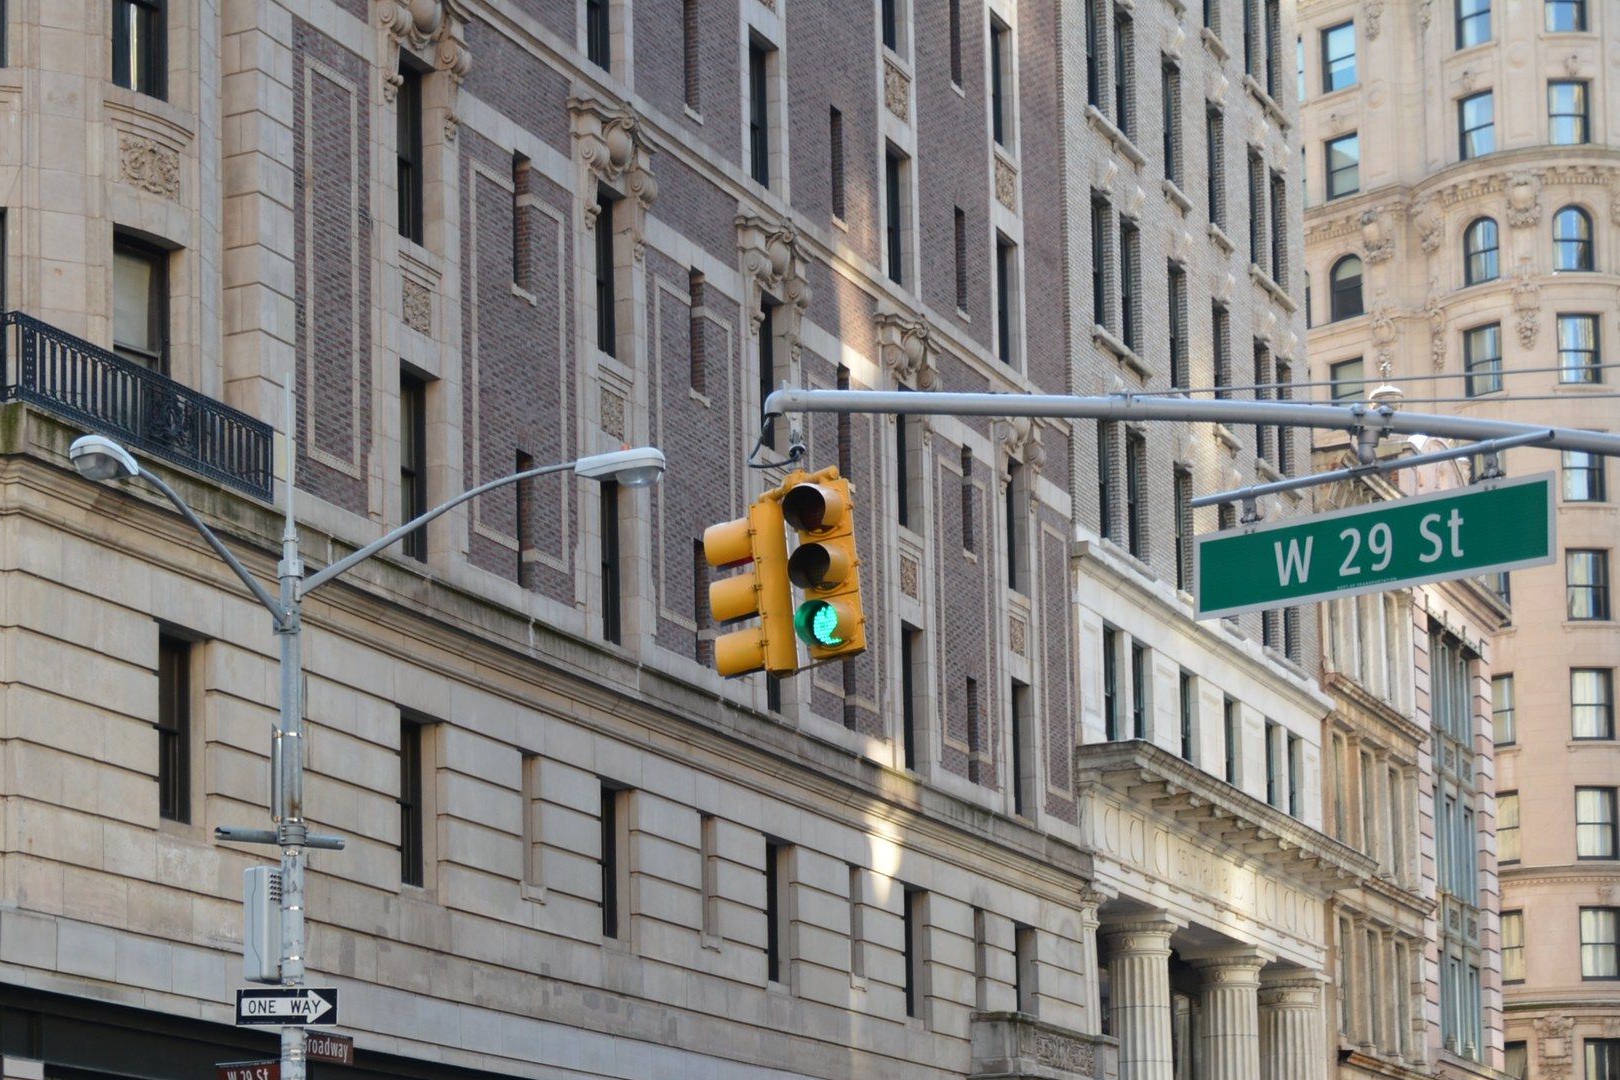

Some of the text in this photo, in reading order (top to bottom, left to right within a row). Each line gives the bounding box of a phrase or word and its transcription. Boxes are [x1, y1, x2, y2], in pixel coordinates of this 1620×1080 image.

[1274, 508, 1464, 586] W 29 St
[248, 1000, 321, 1014] ONE WAY
